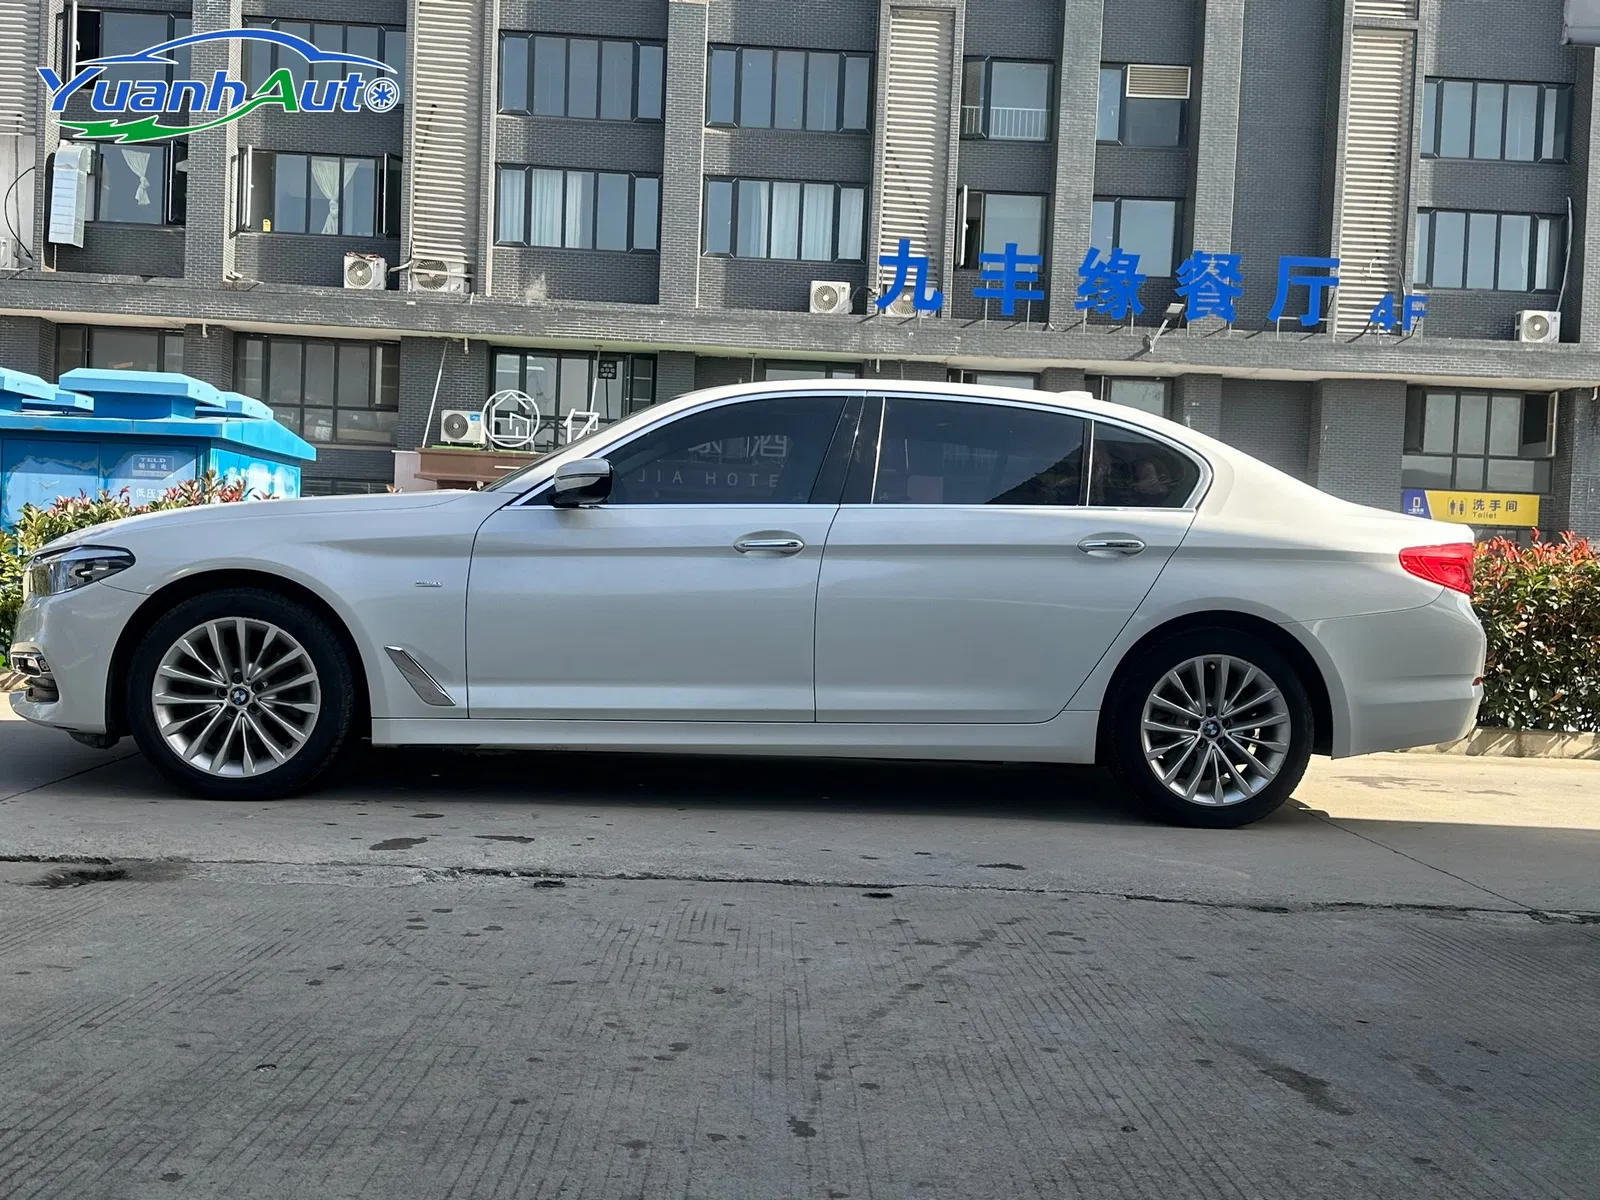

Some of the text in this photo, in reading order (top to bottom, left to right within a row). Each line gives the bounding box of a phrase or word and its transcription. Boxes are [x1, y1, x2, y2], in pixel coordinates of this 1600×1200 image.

[876, 239, 1340, 326] 九丰缘餐厅
[1370, 294, 1428, 331] 4F
[638, 469, 683, 484] JIA
[1472, 498, 1518, 512] 洗手间
[1472, 511, 1498, 519] Toilet
